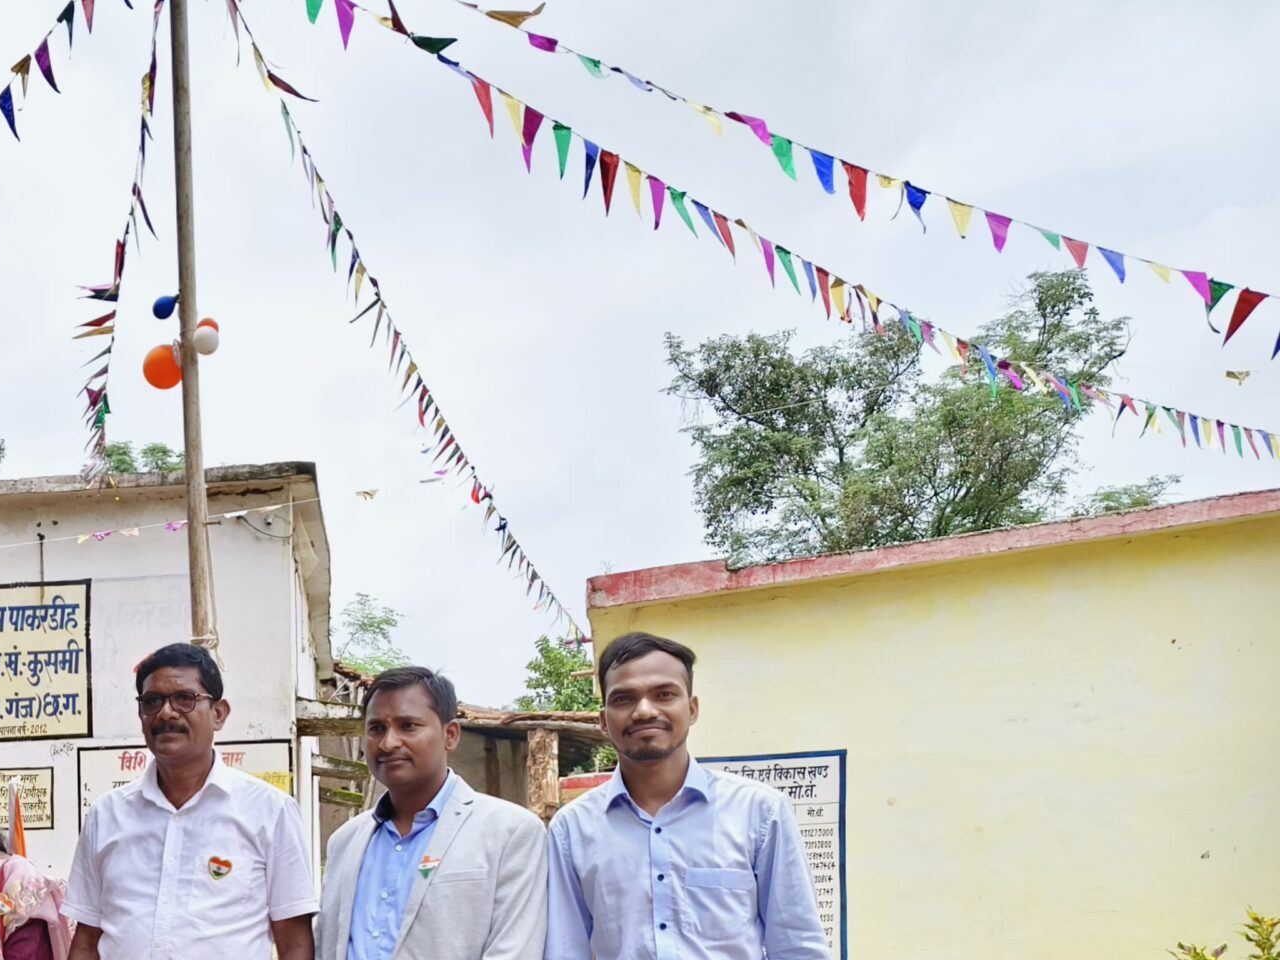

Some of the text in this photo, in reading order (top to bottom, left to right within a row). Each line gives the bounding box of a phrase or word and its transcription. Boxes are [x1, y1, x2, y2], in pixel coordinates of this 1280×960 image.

[8, 595, 80, 635] पाकरडीह
[27, 638, 84, 687] कुसमी
[118, 751, 146, 771] विशि
[773, 763, 807, 781] विकास
[807, 765, 829, 780] खण्ड
